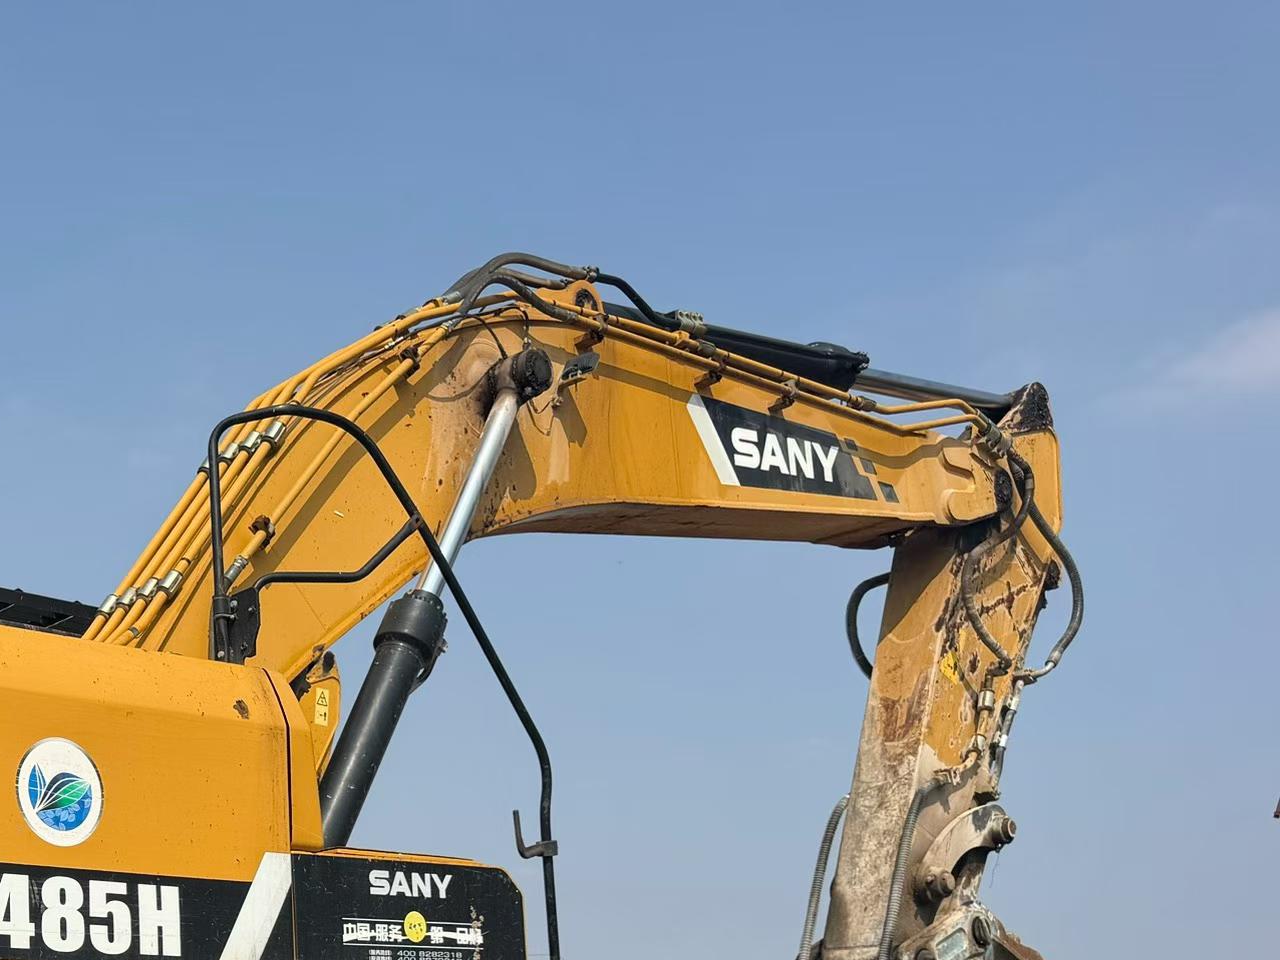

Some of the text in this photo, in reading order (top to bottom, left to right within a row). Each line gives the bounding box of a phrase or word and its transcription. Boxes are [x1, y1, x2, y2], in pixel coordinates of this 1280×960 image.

[731, 427, 839, 482] SANY
[369, 869, 453, 899] SANY
[397, 949, 416, 957] 400
